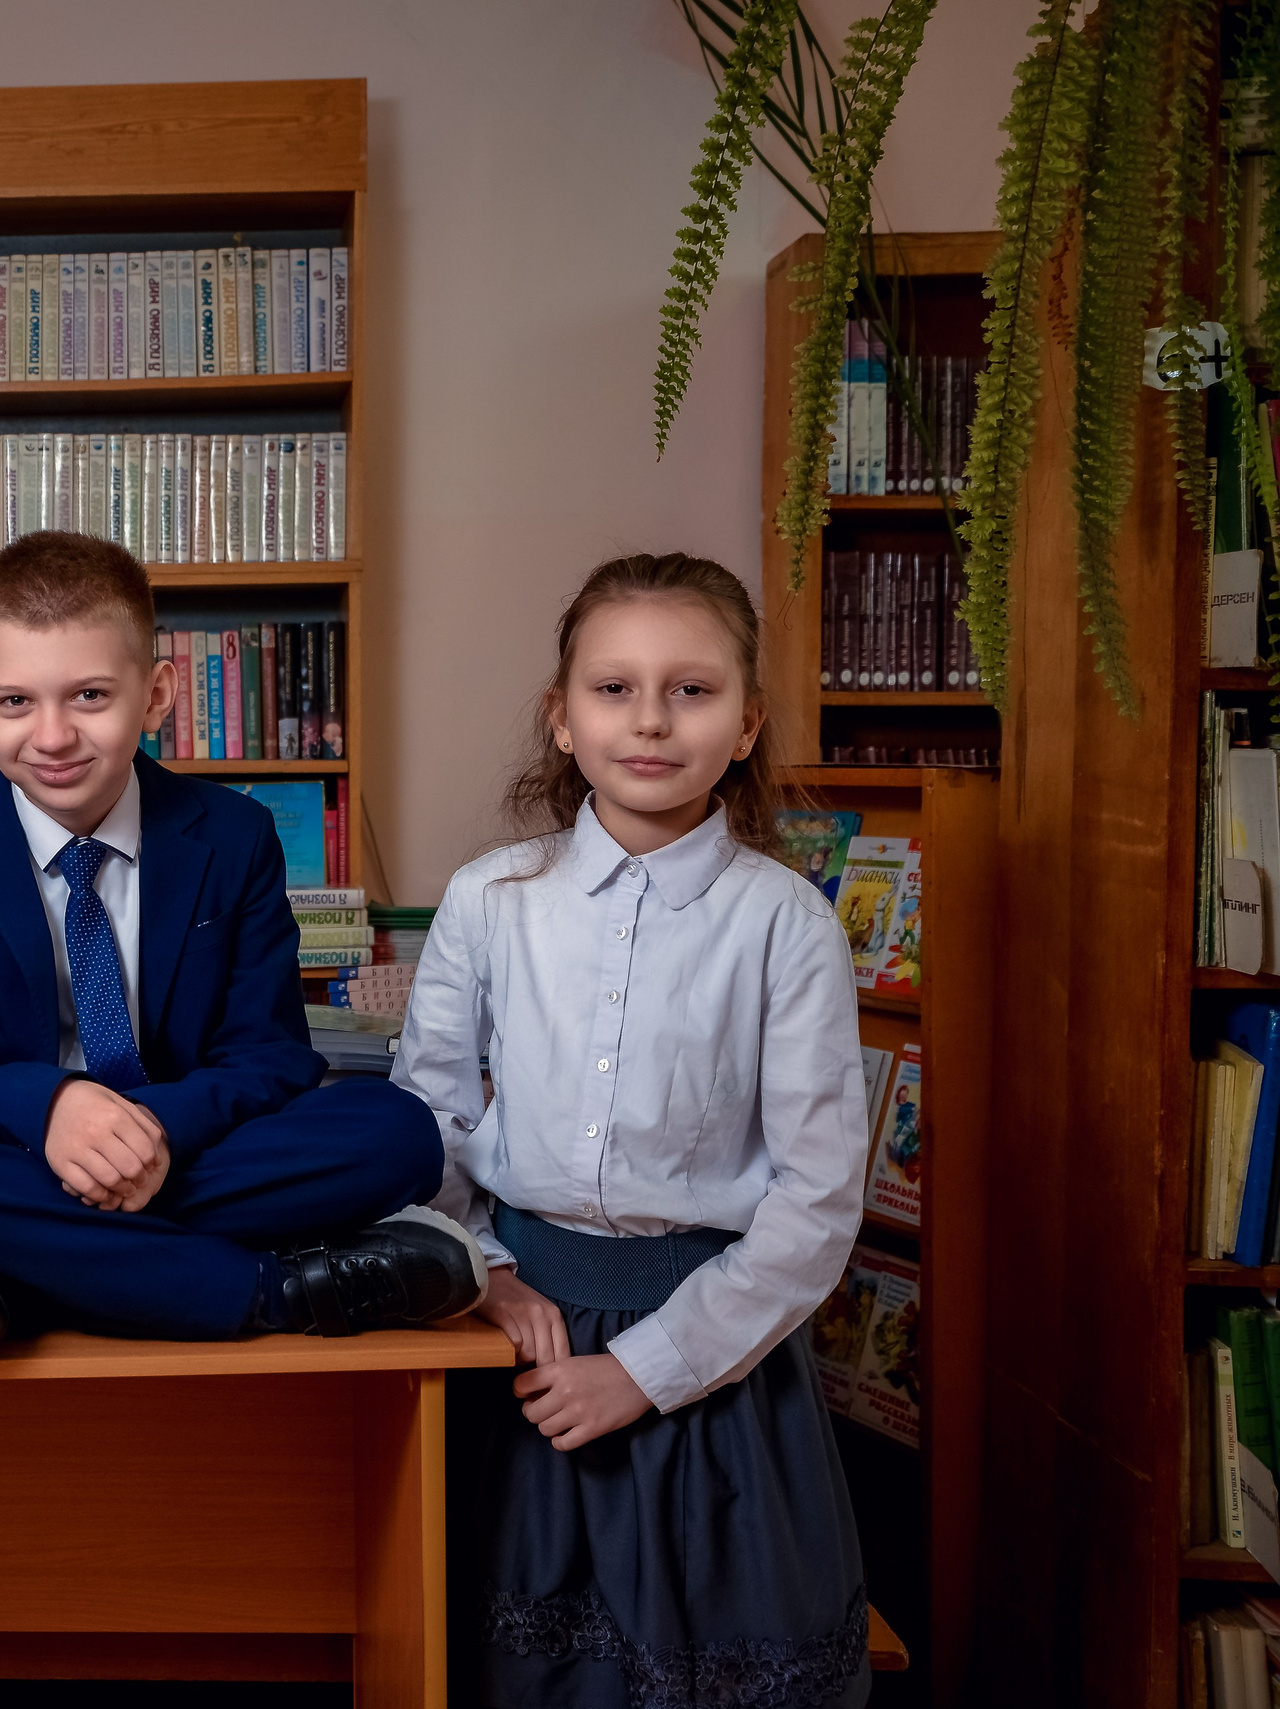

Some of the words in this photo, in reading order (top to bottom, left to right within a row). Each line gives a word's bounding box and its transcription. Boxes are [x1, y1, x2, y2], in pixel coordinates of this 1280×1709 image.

[226, 634, 236, 660] 8
[339, 894, 346, 904] Я
[345, 912, 355, 924] Я
[351, 952, 361, 965] Я
[1224, 1394, 1234, 1433] животных
[1227, 1434, 1235, 1454] мире
[1229, 1467, 1240, 1512] Акимушкин
